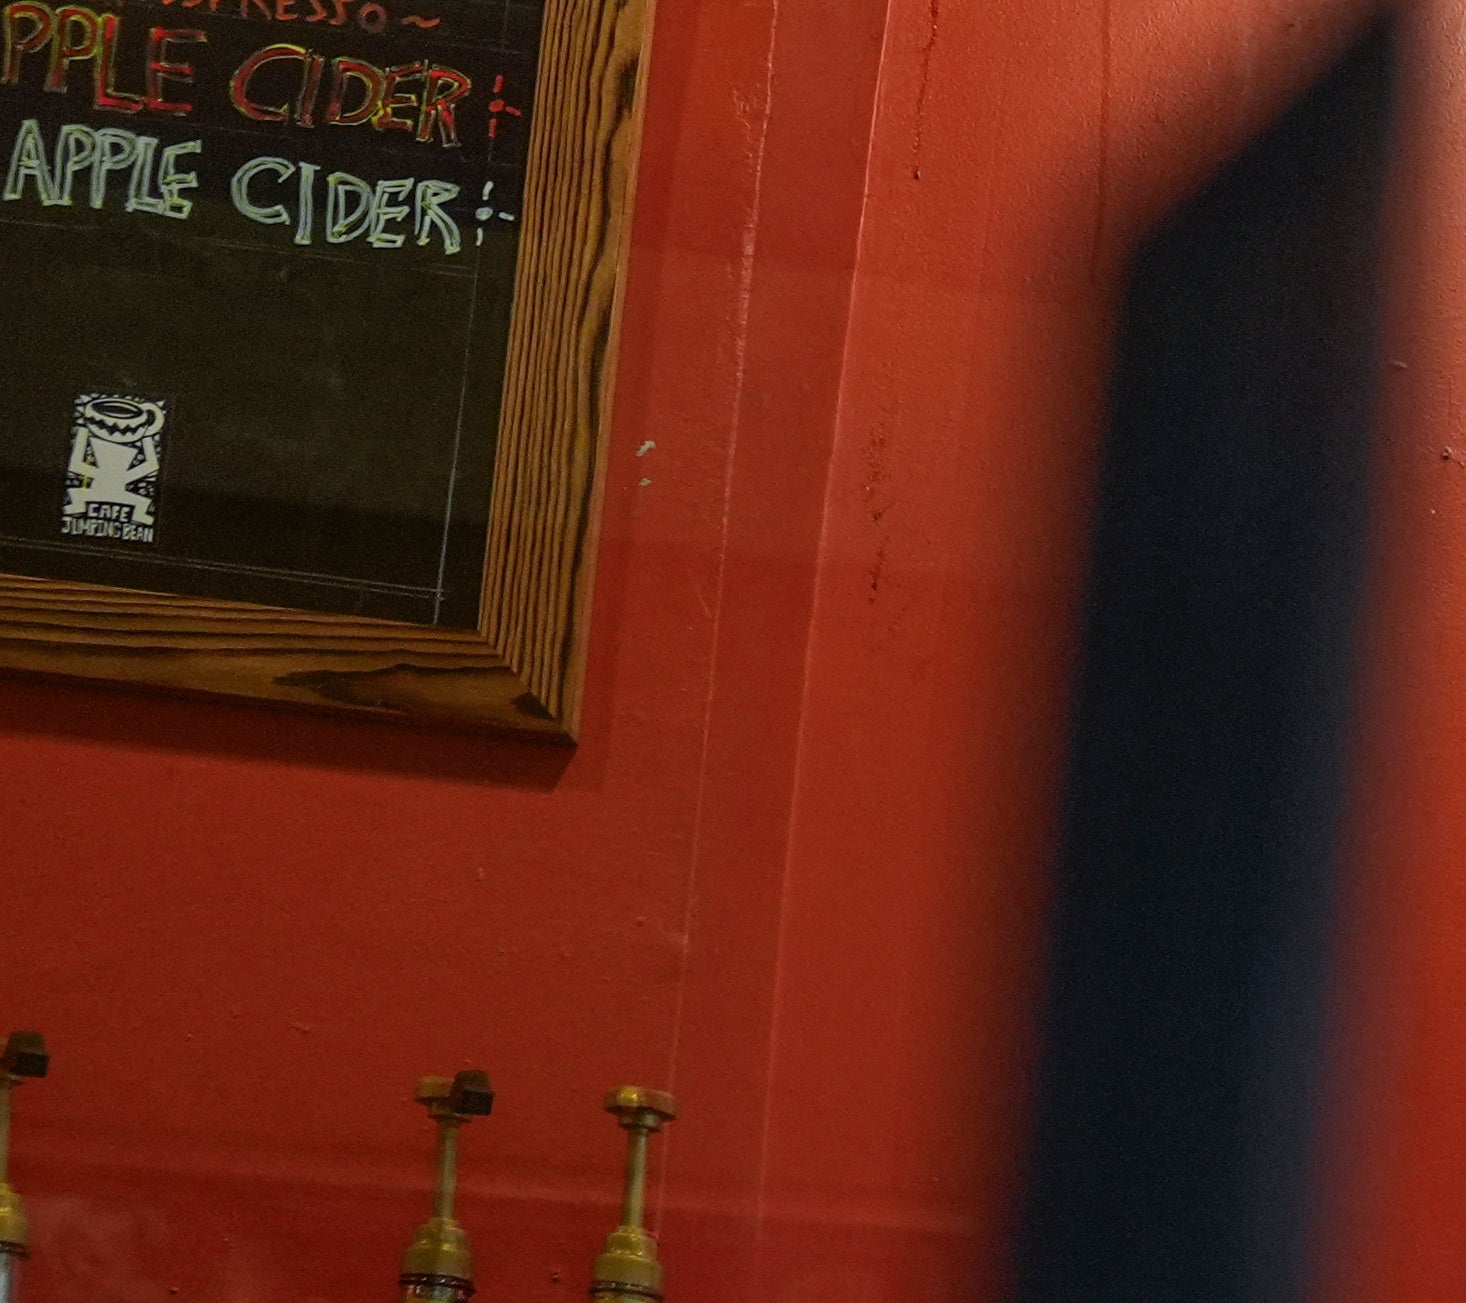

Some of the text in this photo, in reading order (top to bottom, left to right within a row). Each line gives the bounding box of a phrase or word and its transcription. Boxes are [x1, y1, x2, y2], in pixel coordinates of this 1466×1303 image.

[0, 4, 472, 147] PPLE CIDER
[3, 118, 462, 255] APPLE CIDER
[87, 503, 131, 522] CAFE
